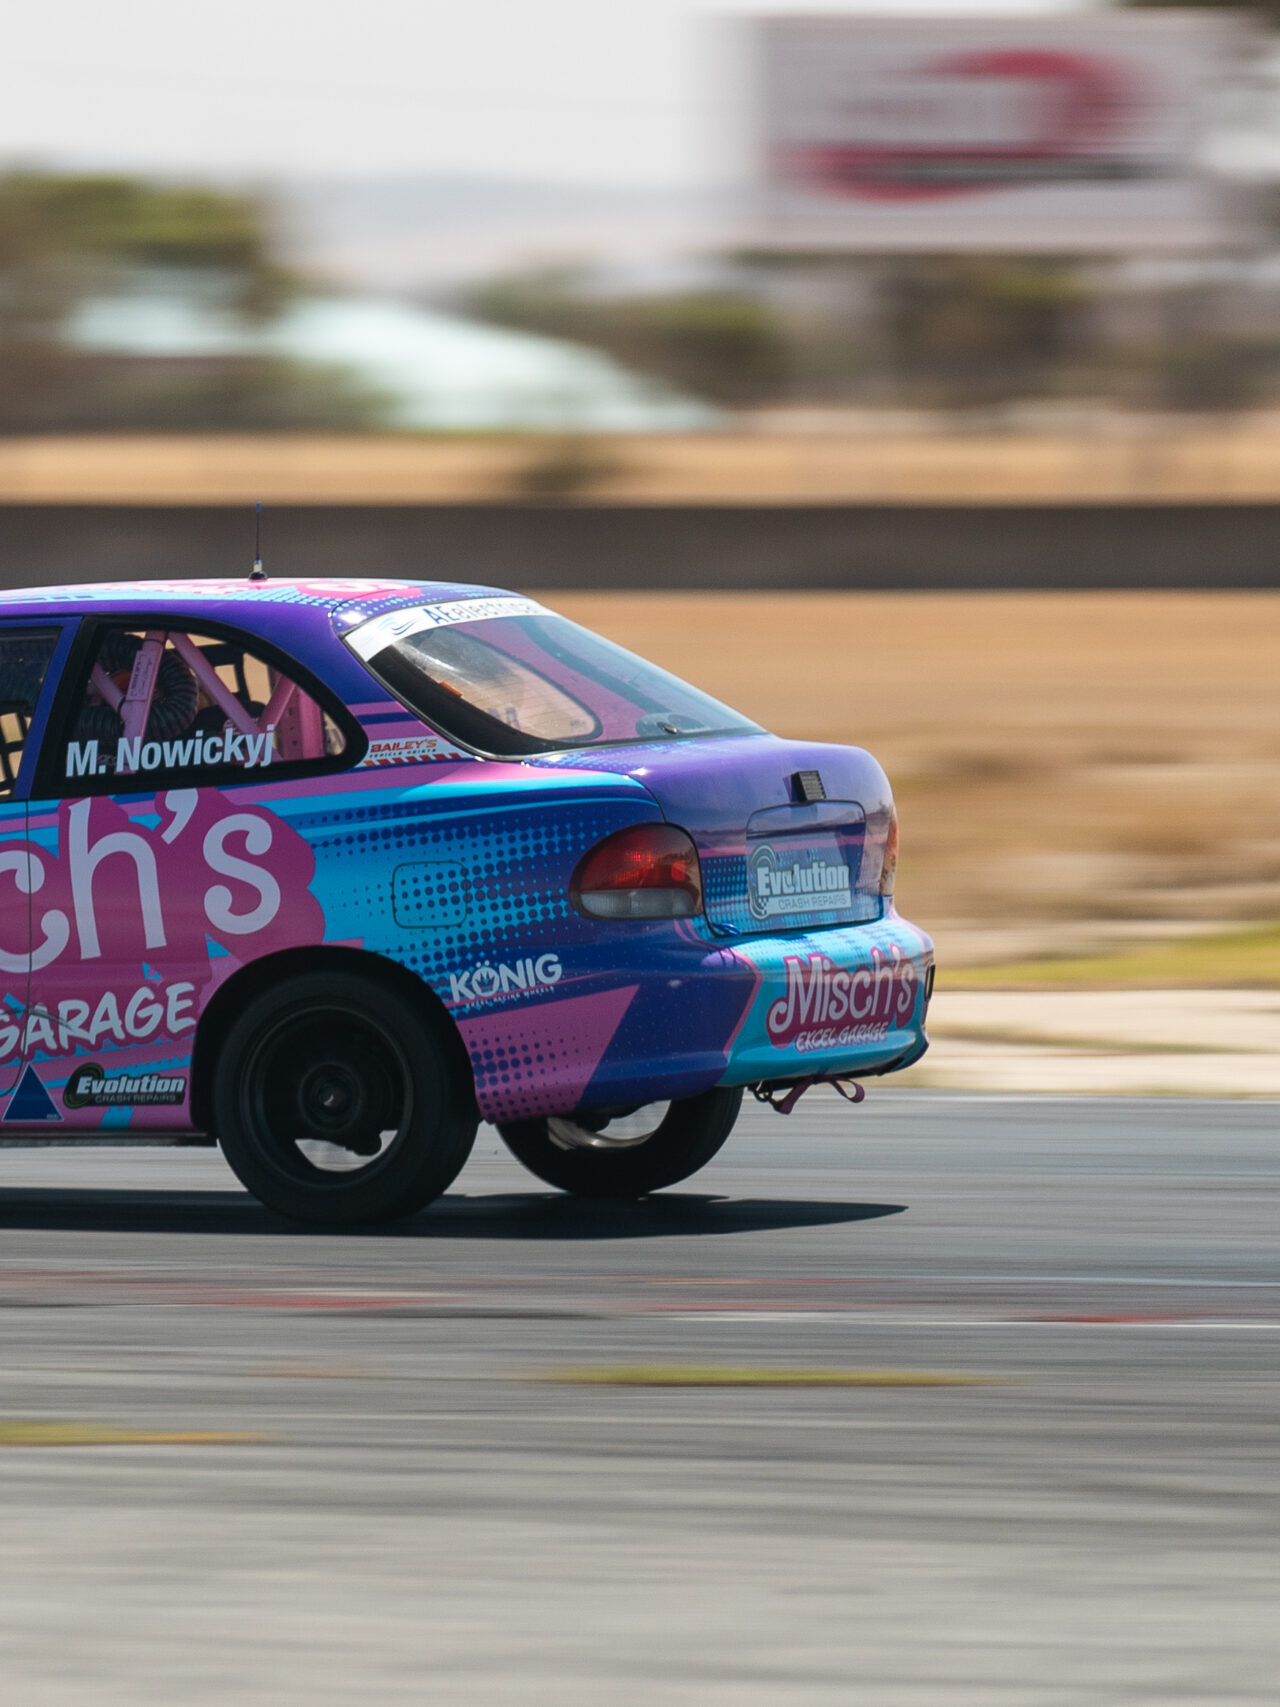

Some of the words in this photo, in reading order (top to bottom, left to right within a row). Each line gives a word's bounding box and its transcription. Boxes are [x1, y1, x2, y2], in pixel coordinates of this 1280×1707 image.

[65, 740, 107, 777] M.
[118, 724, 275, 772] Nowickyj
[757, 861, 850, 896] Evolution
[777, 898, 810, 911] CRASH
[811, 894, 848, 907] REPAIRS
[449, 953, 563, 1003] KÖNIG
[769, 945, 915, 1033] Misch's
[795, 1028, 837, 1051] EXCEL
[837, 1021, 890, 1044] GARAGE
[76, 1075, 186, 1094] Evolution
